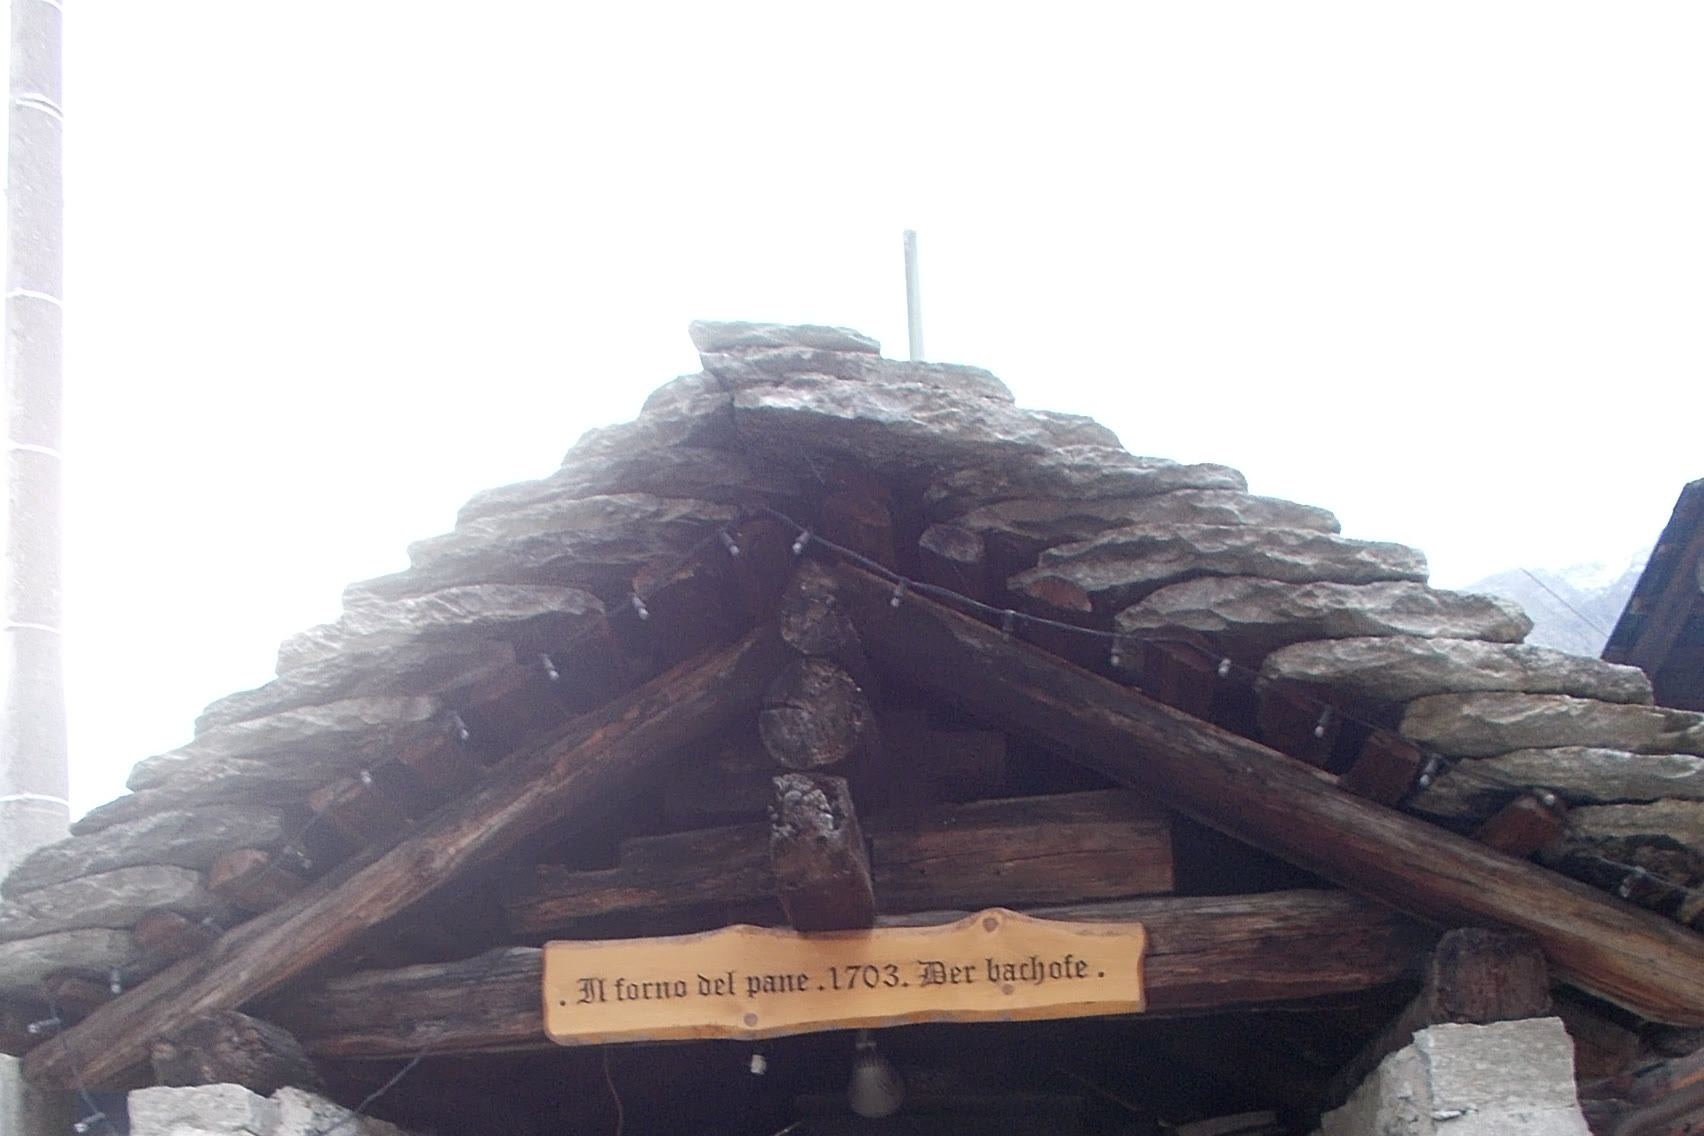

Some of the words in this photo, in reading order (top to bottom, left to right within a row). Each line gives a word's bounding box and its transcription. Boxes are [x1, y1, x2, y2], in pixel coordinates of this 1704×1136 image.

[576, 977, 606, 1005] Il
[614, 977, 688, 1001] forno
[697, 971, 736, 996] del
[745, 972, 809, 999] pane
[917, 959, 977, 988] Der
